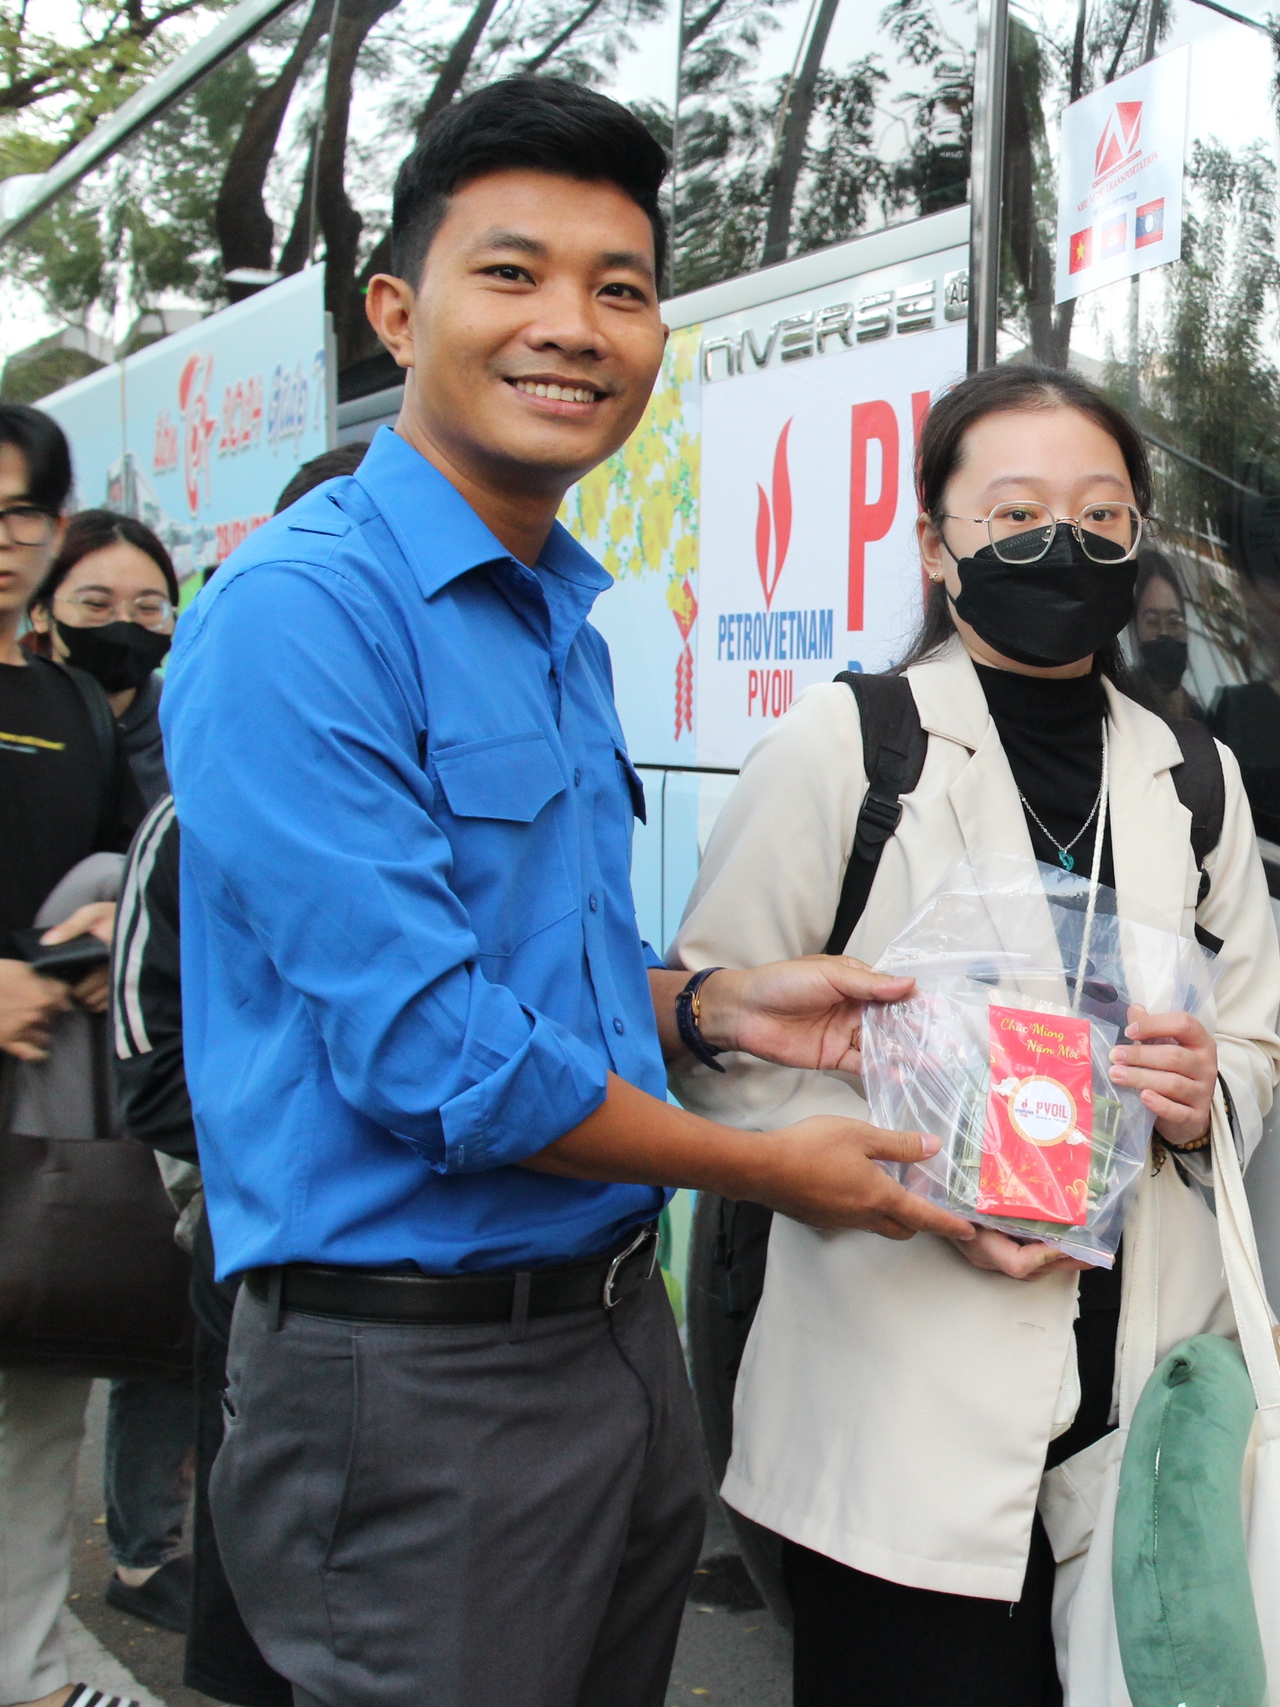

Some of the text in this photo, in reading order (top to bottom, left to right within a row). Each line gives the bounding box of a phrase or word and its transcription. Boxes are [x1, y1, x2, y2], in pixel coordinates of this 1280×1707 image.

[718, 608, 833, 661] PETROVIETNAM
[1001, 1018, 1029, 1034] Chúc
[1027, 1039, 1055, 1055] Năm
[1036, 1100, 1068, 1119] PVOIL
